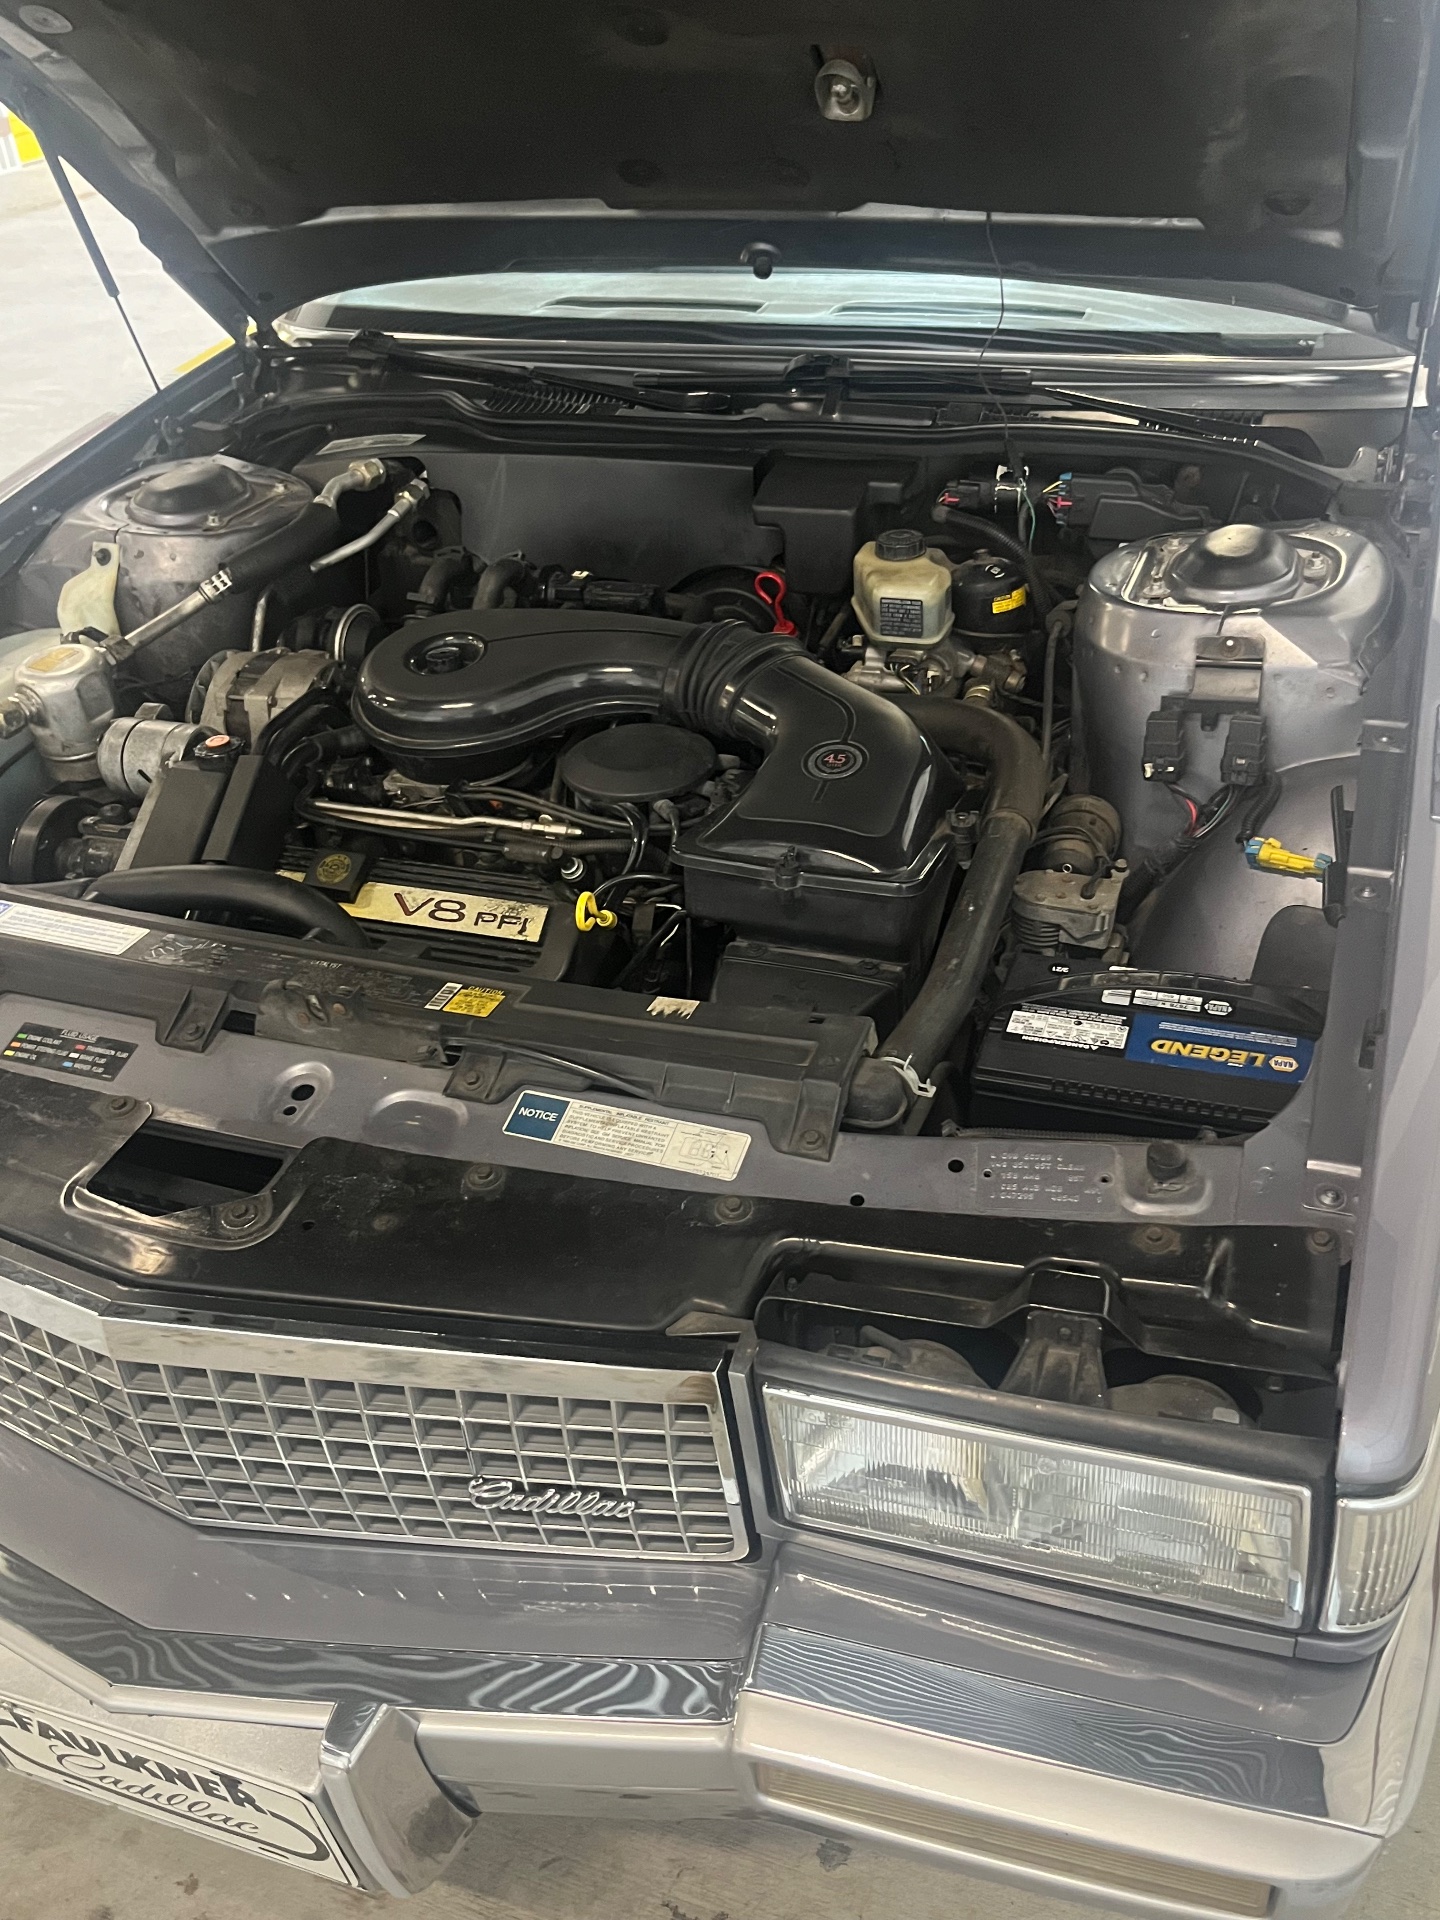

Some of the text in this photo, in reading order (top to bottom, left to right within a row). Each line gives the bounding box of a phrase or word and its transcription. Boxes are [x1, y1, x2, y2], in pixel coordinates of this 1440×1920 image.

[393, 892, 466, 923] V8
[467, 985, 504, 996] CAUTION
[1150, 1039, 1295, 1069] NAPA LEGEND
[518, 1106, 558, 1121] NOTICE
[468, 1478, 636, 1519] Cadillac
[9, 1711, 269, 1815] FAULKNER
[48, 1744, 260, 1835] Cadillac
